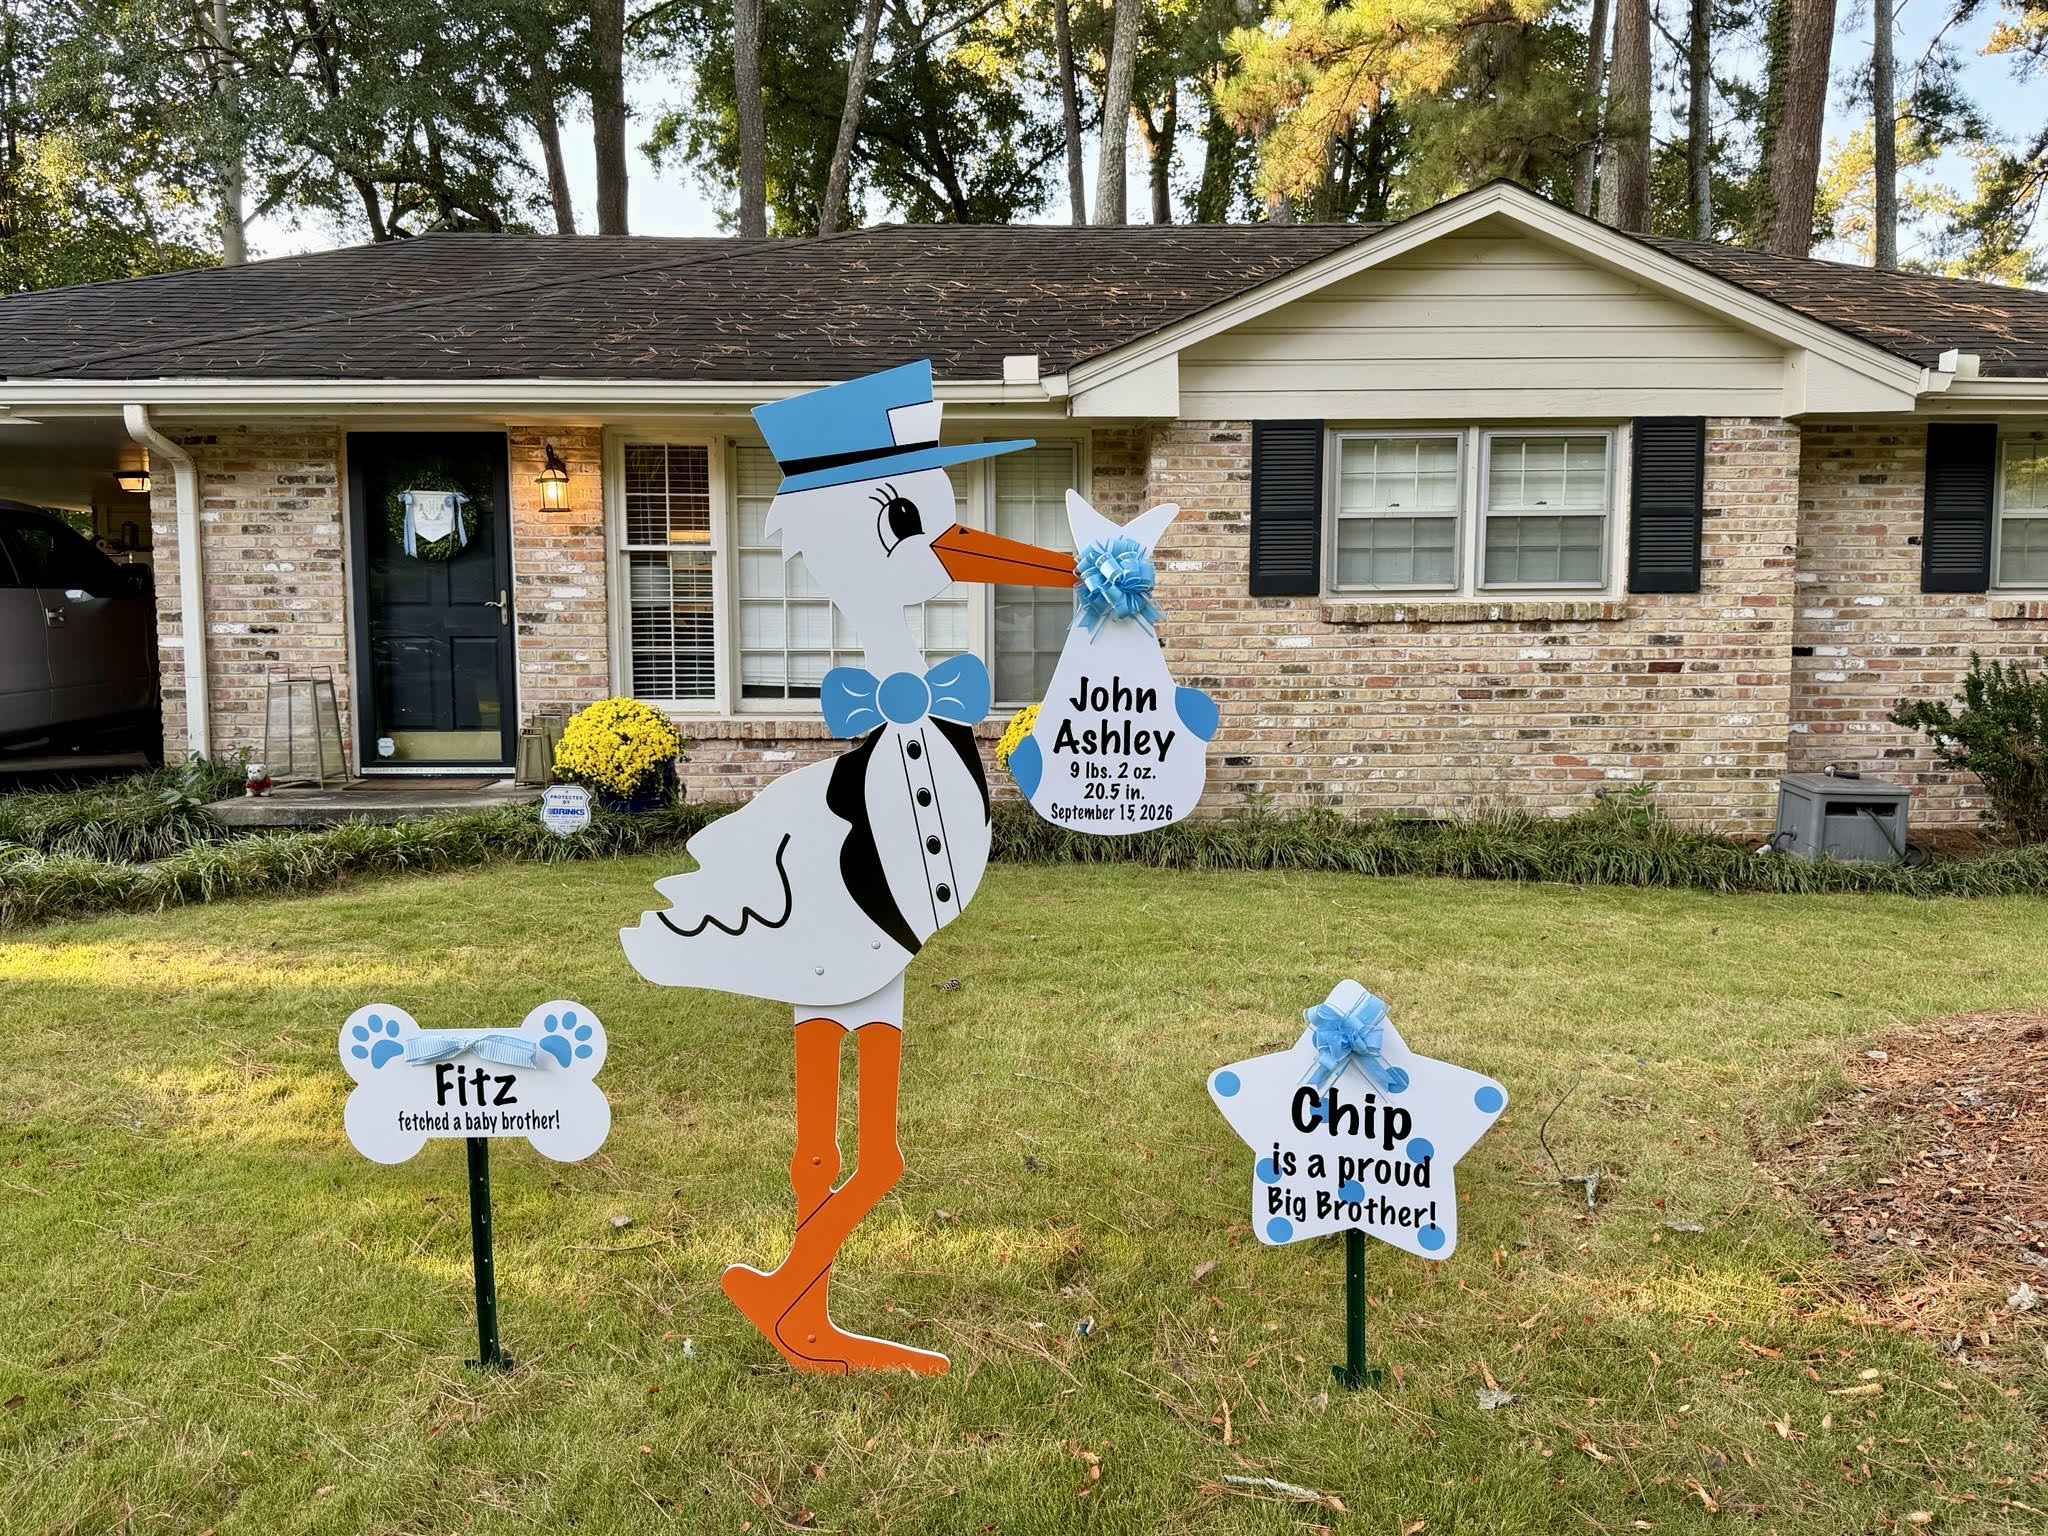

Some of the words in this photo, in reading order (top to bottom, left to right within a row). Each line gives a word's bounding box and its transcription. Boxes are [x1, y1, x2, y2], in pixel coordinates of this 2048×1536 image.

[1069, 676, 1158, 713] John
[1053, 719, 1176, 762] Ashley
[1070, 761, 1080, 779] 9
[1085, 761, 1111, 779] lbs.
[1117, 761, 1129, 779] 2
[1133, 766, 1157, 780] oz.
[1083, 783, 1121, 800] 20.5
[1126, 783, 1145, 801] in.
[1051, 803, 1115, 822] September
[1120, 804, 1136, 822] 15,
[1139, 804, 1173, 821] 2026
[435, 1062, 518, 1107] Fitz
[398, 1110, 450, 1132] fetched
[453, 1116, 462, 1131] a
[465, 1111, 498, 1134] baby
[501, 1109, 561, 1131] brother!
[1291, 1086, 1412, 1152] Chip
[1272, 1142, 1297, 1177] is
[1307, 1154, 1327, 1179] a
[1338, 1154, 1431, 1189] proud
[1267, 1185, 1308, 1223] Big
[1316, 1190, 1437, 1232] Brother!
